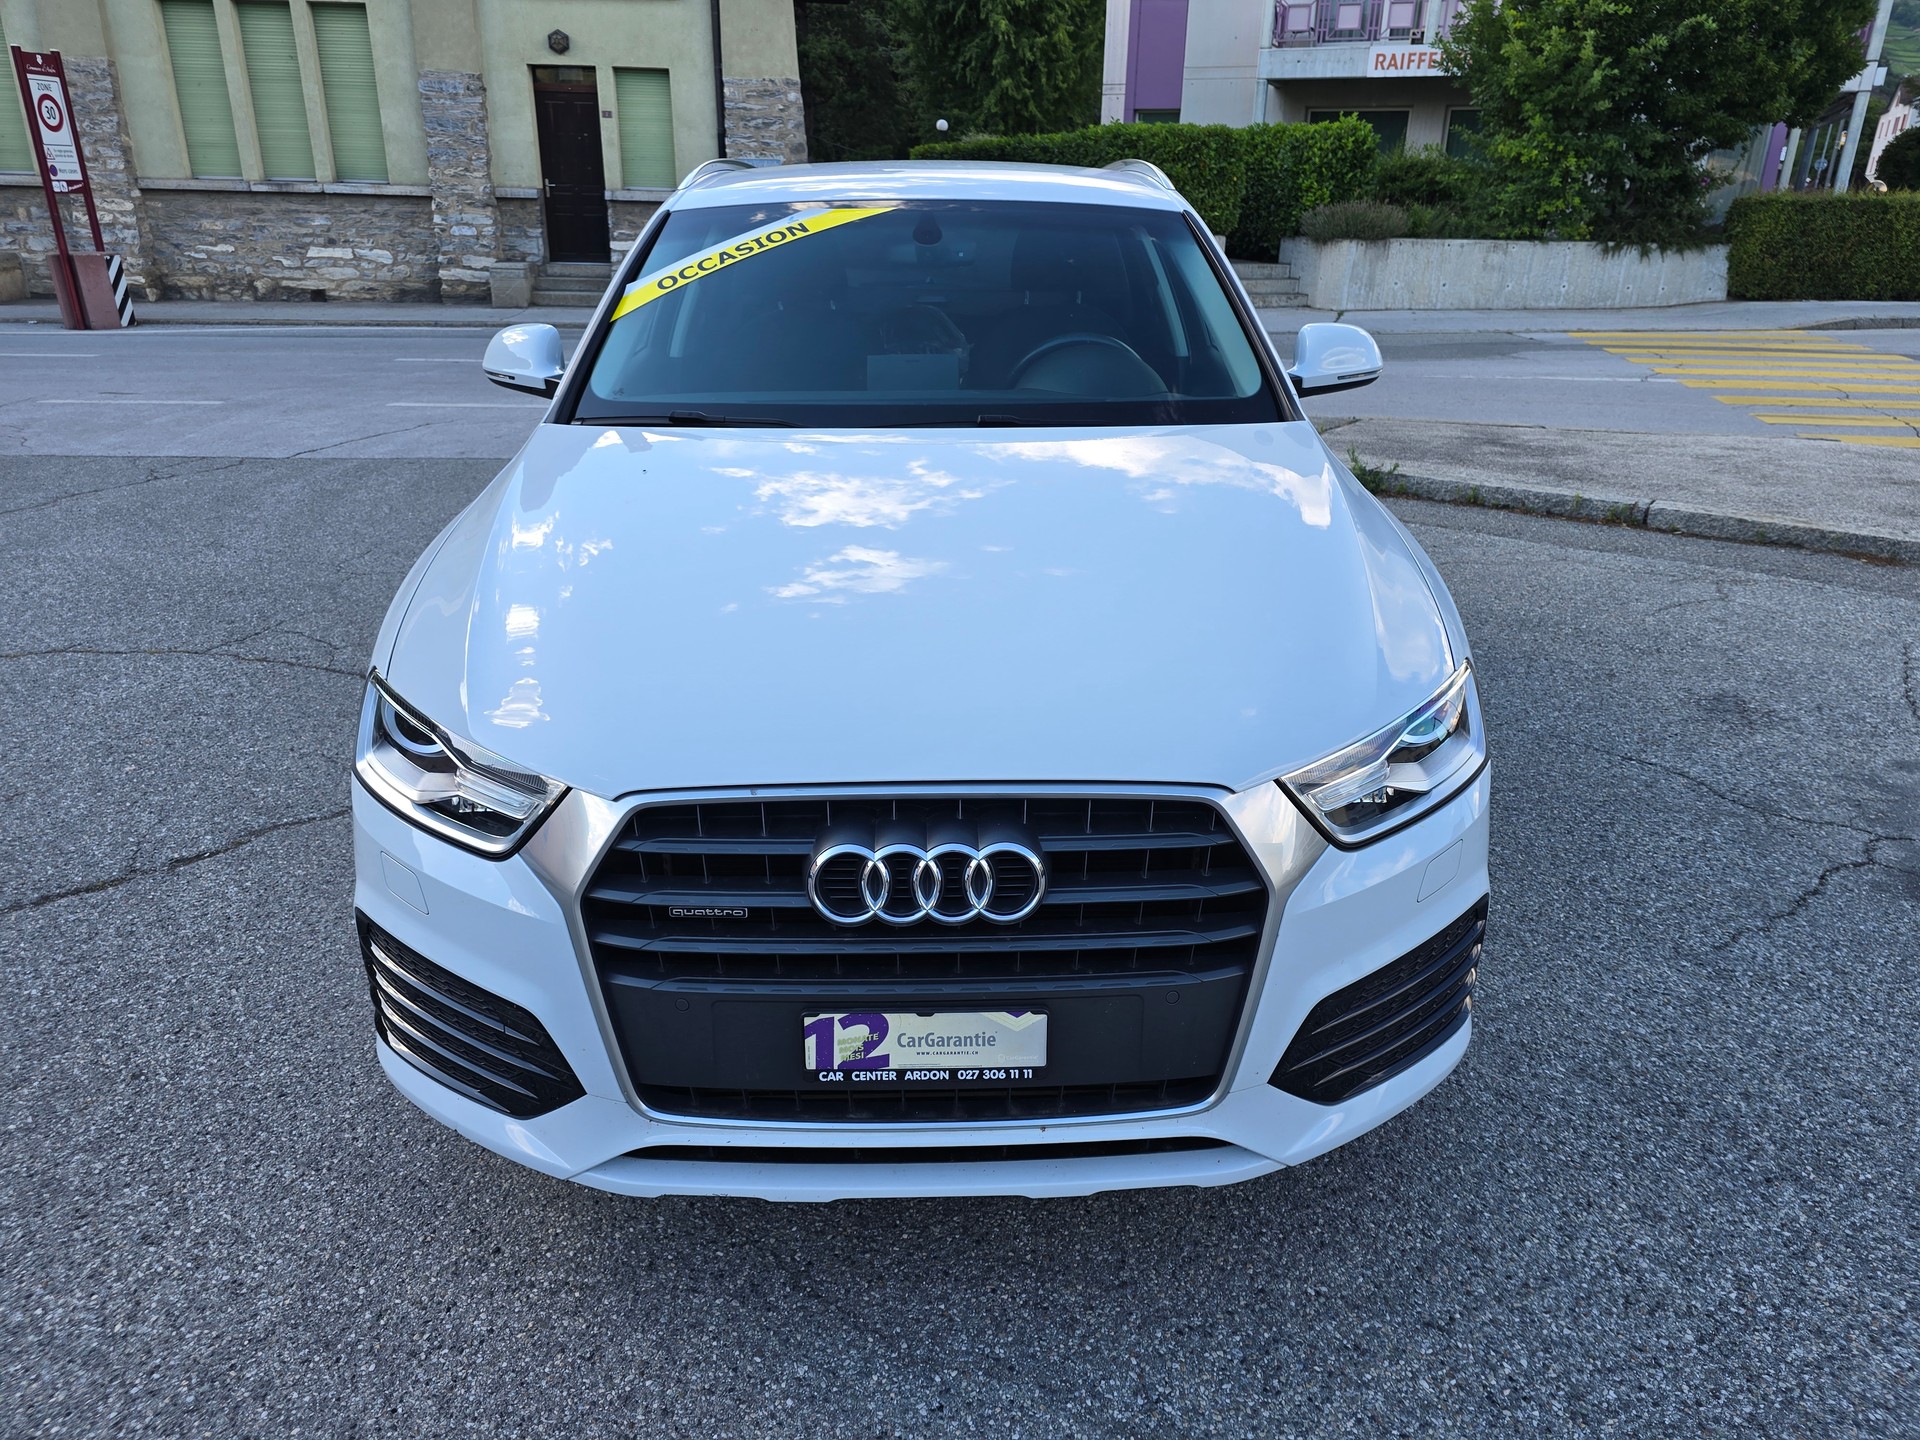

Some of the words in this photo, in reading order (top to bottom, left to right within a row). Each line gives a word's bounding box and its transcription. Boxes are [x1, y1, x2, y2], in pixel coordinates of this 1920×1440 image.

[1374, 50, 1466, 70] RAIFFE
[36, 82, 52, 92] ZONE
[45, 105, 56, 120] 30
[657, 222, 810, 290] OCCASION
[672, 908, 744, 917] quattro
[804, 1012, 890, 1069] 12
[837, 1032, 879, 1046] MONATE
[839, 1043, 864, 1054] MOIS
[819, 1071, 844, 1081] CAR
[851, 1071, 897, 1081] CENTER
[904, 1070, 949, 1080] ARDON
[957, 1070, 980, 1080] 027
[982, 1069, 1006, 1079] 306
[1009, 1069, 1019, 1079] 11
[1023, 1069, 1033, 1079] 11
